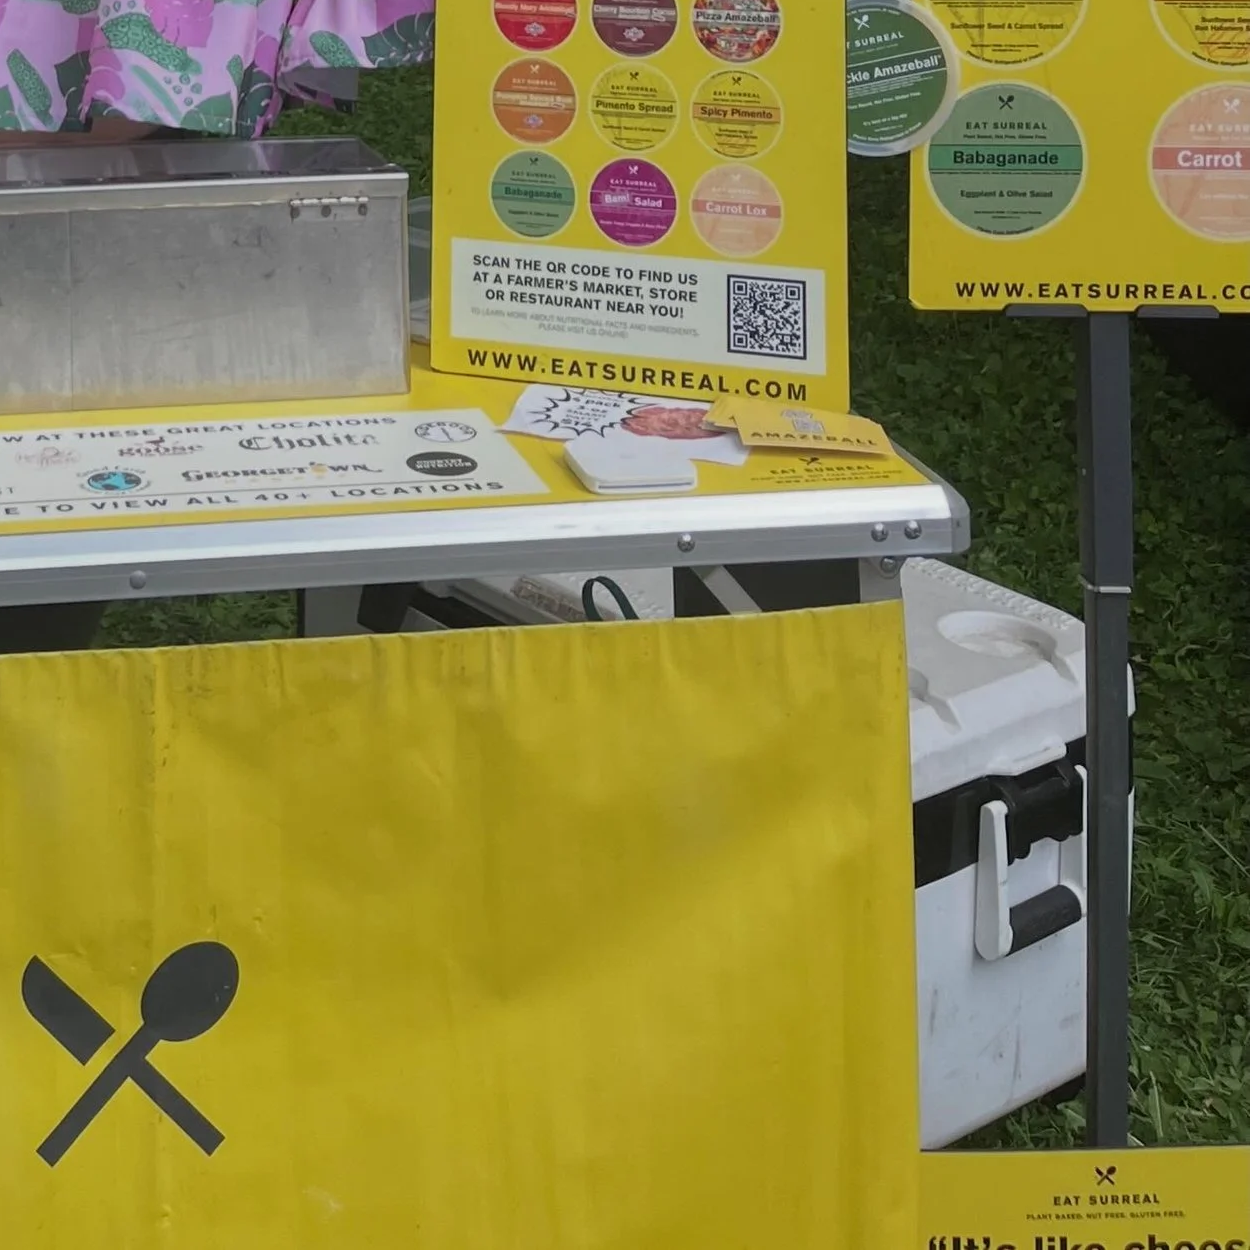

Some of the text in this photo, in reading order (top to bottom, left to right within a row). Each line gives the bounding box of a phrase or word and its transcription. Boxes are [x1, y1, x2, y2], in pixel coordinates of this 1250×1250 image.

[854, 30, 905, 48] SURREAL
[873, 54, 939, 79] Amazeball
[953, 150, 1059, 169] Babaganade
[1177, 149, 1243, 168] Carrot
[473, 254, 698, 286] SCAN THE QR CODE TO FIND US
[473, 271, 698, 303] AT A FARMER'S MARKET, STORE
[955, 282, 1250, 301] WWW.EATSURREAL.CO
[485, 289, 684, 319] OR RESTAURANT NEAR YOU!
[507, 311, 528, 320] MORE
[529, 312, 555, 323] ABOUT
[605, 319, 628, 330] FACTS
[630, 321, 647, 331] AND
[467, 347, 808, 402] WWW.EATSURREAL.COM
[35, 433, 63, 442] AT
[77, 427, 156, 440] THESE
[167, 424, 245, 435] GREAT
[258, 417, 398, 430] LOCATIONS
[751, 431, 879, 447] AMAZEBALL
[37, 503, 75, 514] TO
[90, 497, 169, 511] VIEW
[186, 494, 239, 506] ALL
[254, 492, 310, 502] 40+
[330, 481, 505, 498] LOCATIONS
[1053, 1193, 1160, 1207] EAT SURREAL
